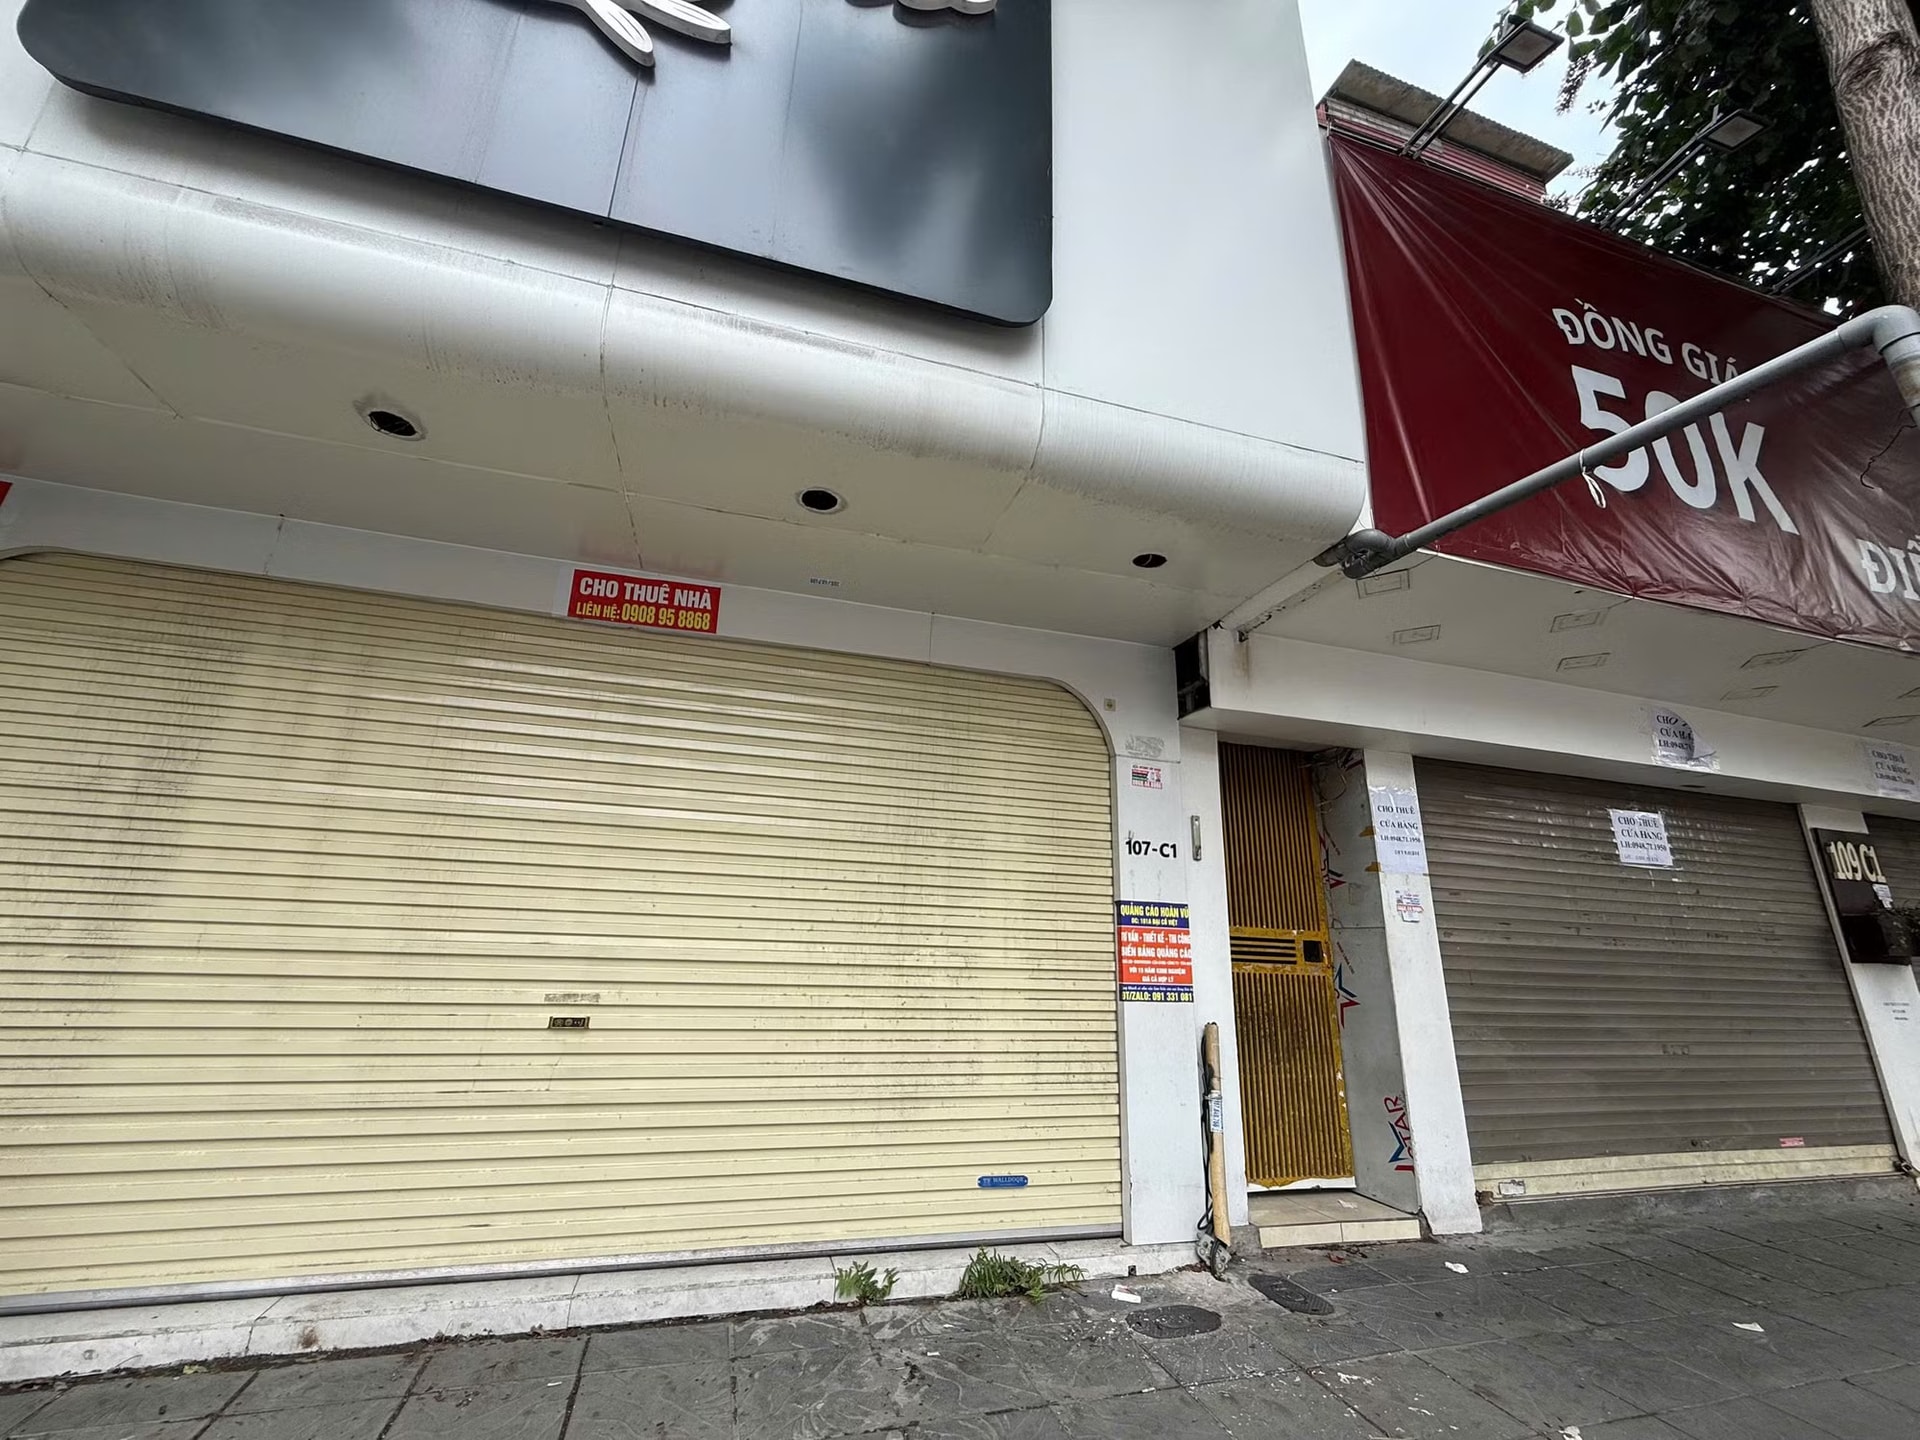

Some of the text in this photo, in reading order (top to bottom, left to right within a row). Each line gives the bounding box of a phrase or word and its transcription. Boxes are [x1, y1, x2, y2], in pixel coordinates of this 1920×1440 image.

[1552, 298, 1674, 366] ĐỒNG
[1571, 365, 1799, 536] 50K
[580, 577, 712, 609] CHO THUÊ NHÀ
[576, 601, 711, 631] LIÊN HỆ: 0908 95 8868
[1377, 805, 1416, 815] CHO THUÊ
[1379, 819, 1419, 830] CỬA HÀNG
[1618, 816, 1660, 828] CHO THUÊ
[1621, 827, 1663, 840] CỬA HÀNG
[1126, 839, 1177, 858] 107-C1
[1120, 902, 1144, 916] QUẢNG
[1145, 904, 1159, 917] CÁO
[1160, 905, 1179, 918] HOÀN
[1152, 992, 1165, 1001] 091
[1166, 992, 1178, 1001] 331
